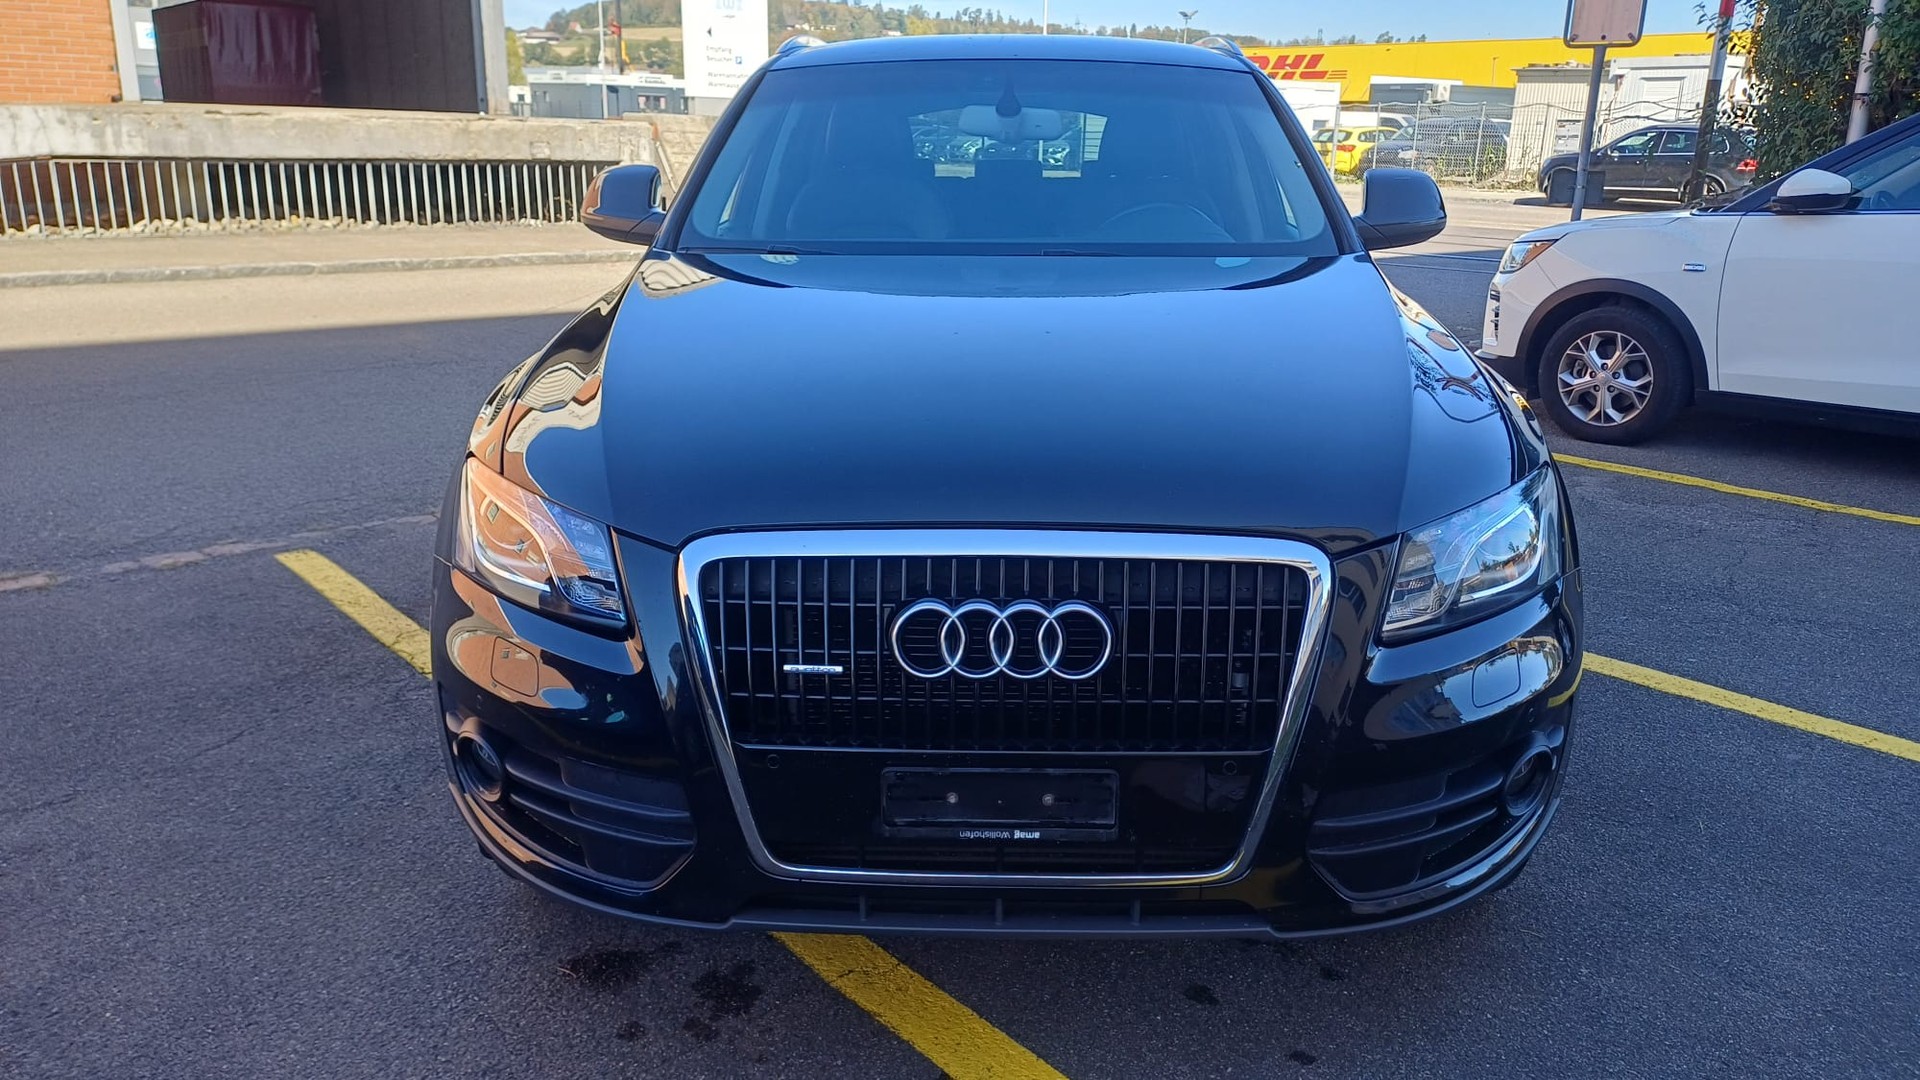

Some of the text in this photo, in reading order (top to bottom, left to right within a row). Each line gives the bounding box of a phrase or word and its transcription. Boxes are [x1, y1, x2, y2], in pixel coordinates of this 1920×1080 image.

[706, 45, 732, 55] Empfang
[959, 829, 1040, 840] amag Wollishofen
